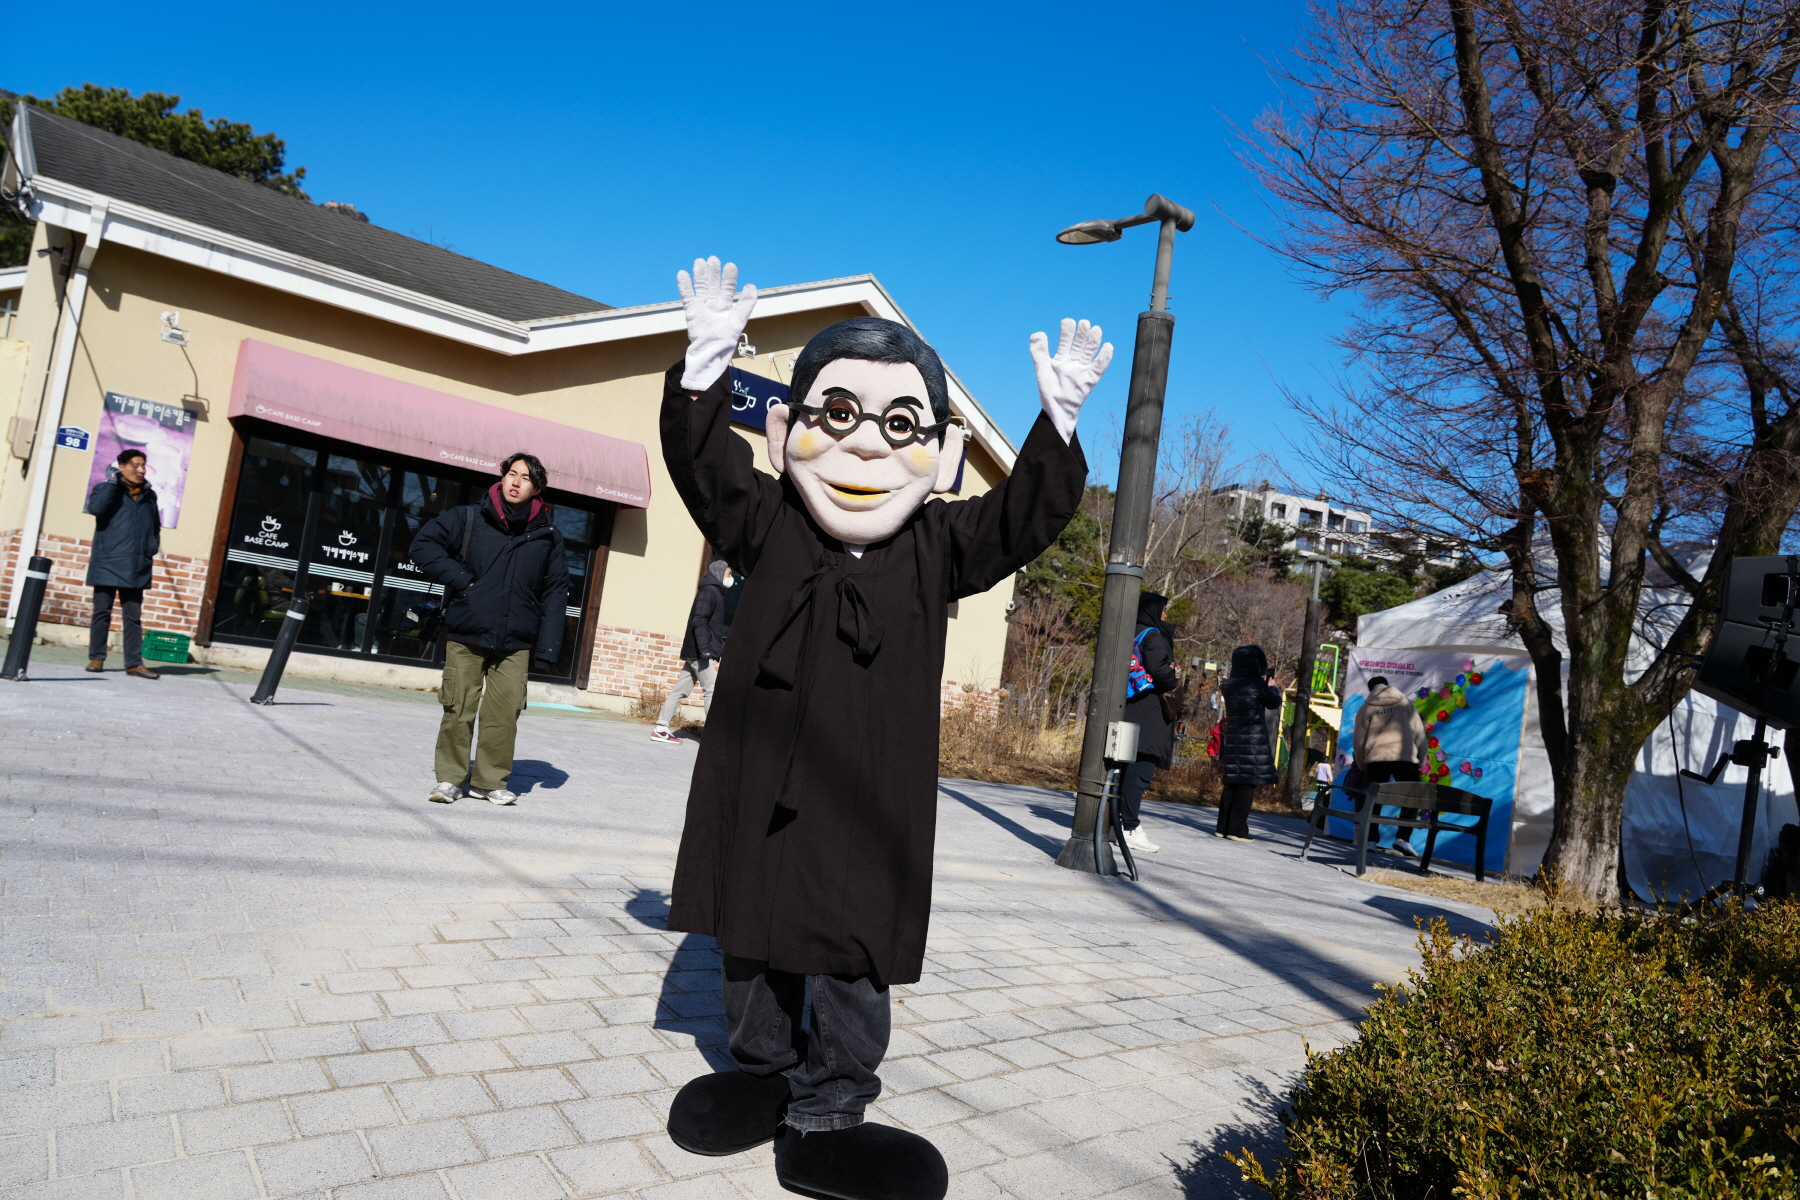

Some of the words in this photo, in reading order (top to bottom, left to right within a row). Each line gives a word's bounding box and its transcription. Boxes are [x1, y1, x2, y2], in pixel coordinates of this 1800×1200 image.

[267, 408, 284, 418] CAFE
[285, 413, 301, 422] BASE
[301, 417, 322, 427] CAMP
[65, 436, 81, 448] 98
[450, 453, 465, 461] CAFE
[465, 456, 479, 464] BASE
[479, 459, 497, 468] CAMP
[604, 488, 617, 496] CAFE
[617, 491, 629, 499] BASE
[628, 494, 644, 502] CAMP
[244, 535, 264, 545] BASE
[264, 539, 289, 549] CAMP
[258, 531, 278, 540] CAFE
[397, 562, 414, 571] BASE
